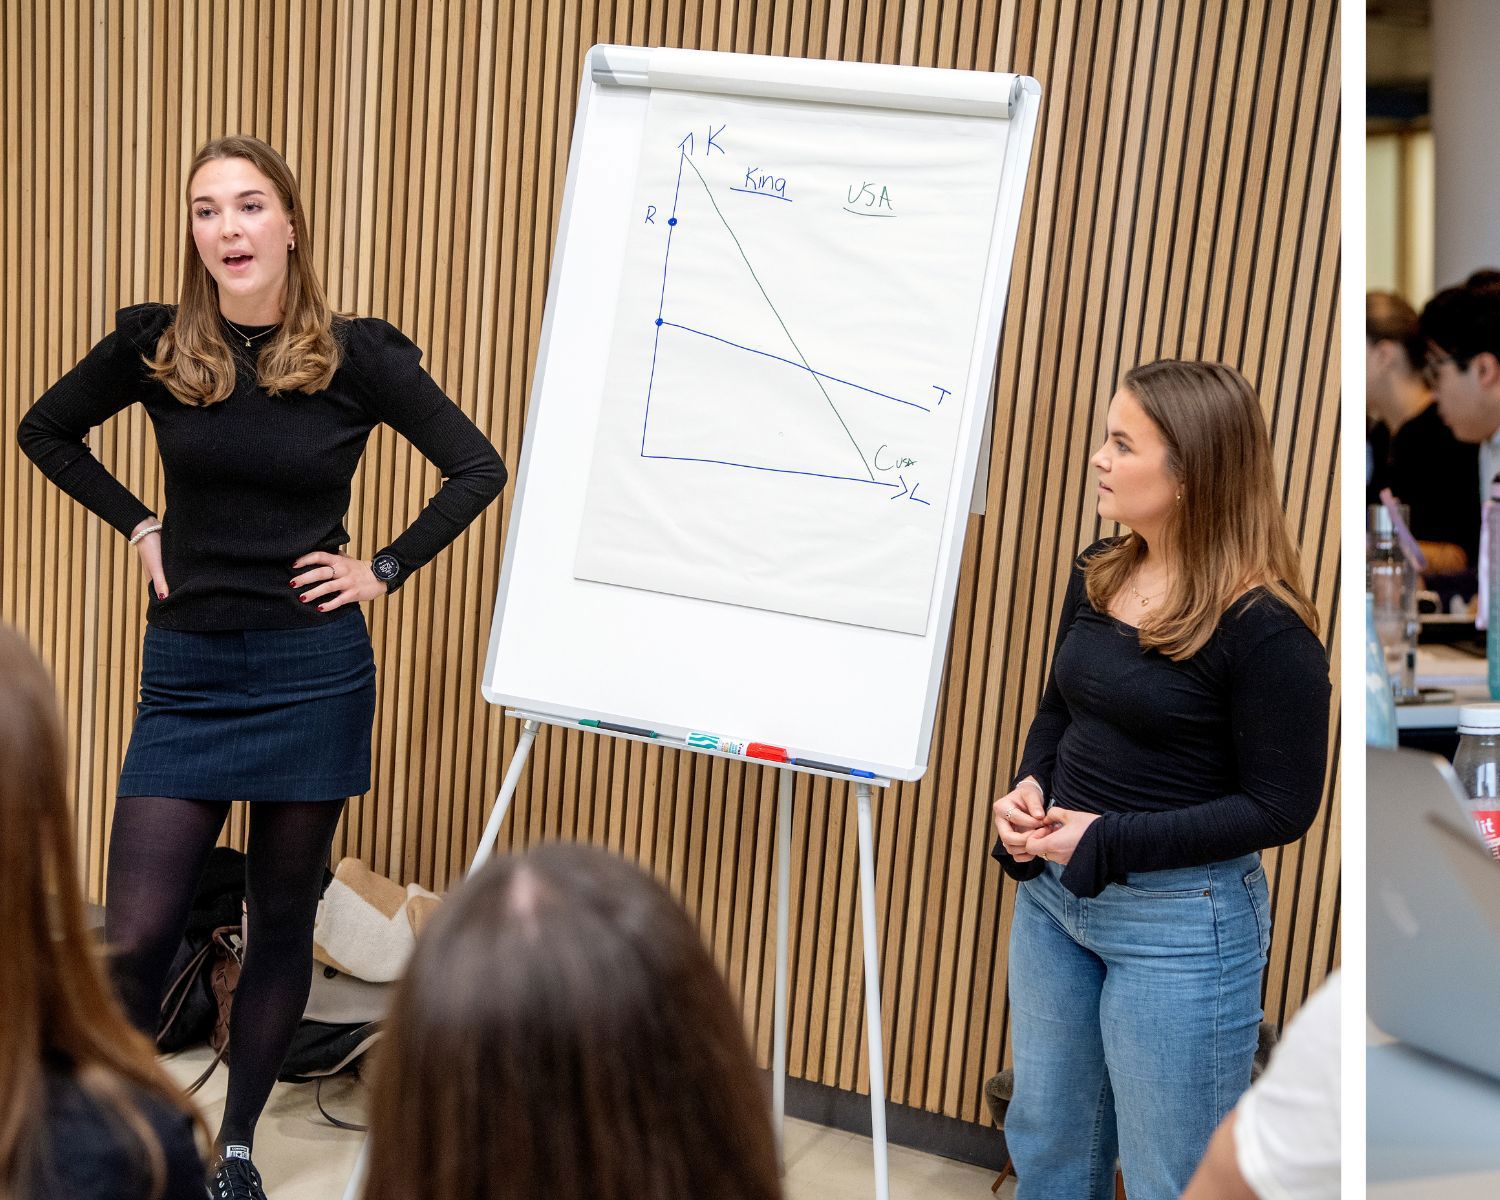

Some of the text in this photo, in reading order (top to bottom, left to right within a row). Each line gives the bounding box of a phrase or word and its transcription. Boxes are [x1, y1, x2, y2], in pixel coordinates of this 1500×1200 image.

[706, 124, 727, 156] K
[847, 181, 893, 211] USA
[644, 205, 657, 225] R
[932, 385, 952, 406] T
[909, 482, 931, 506] L
